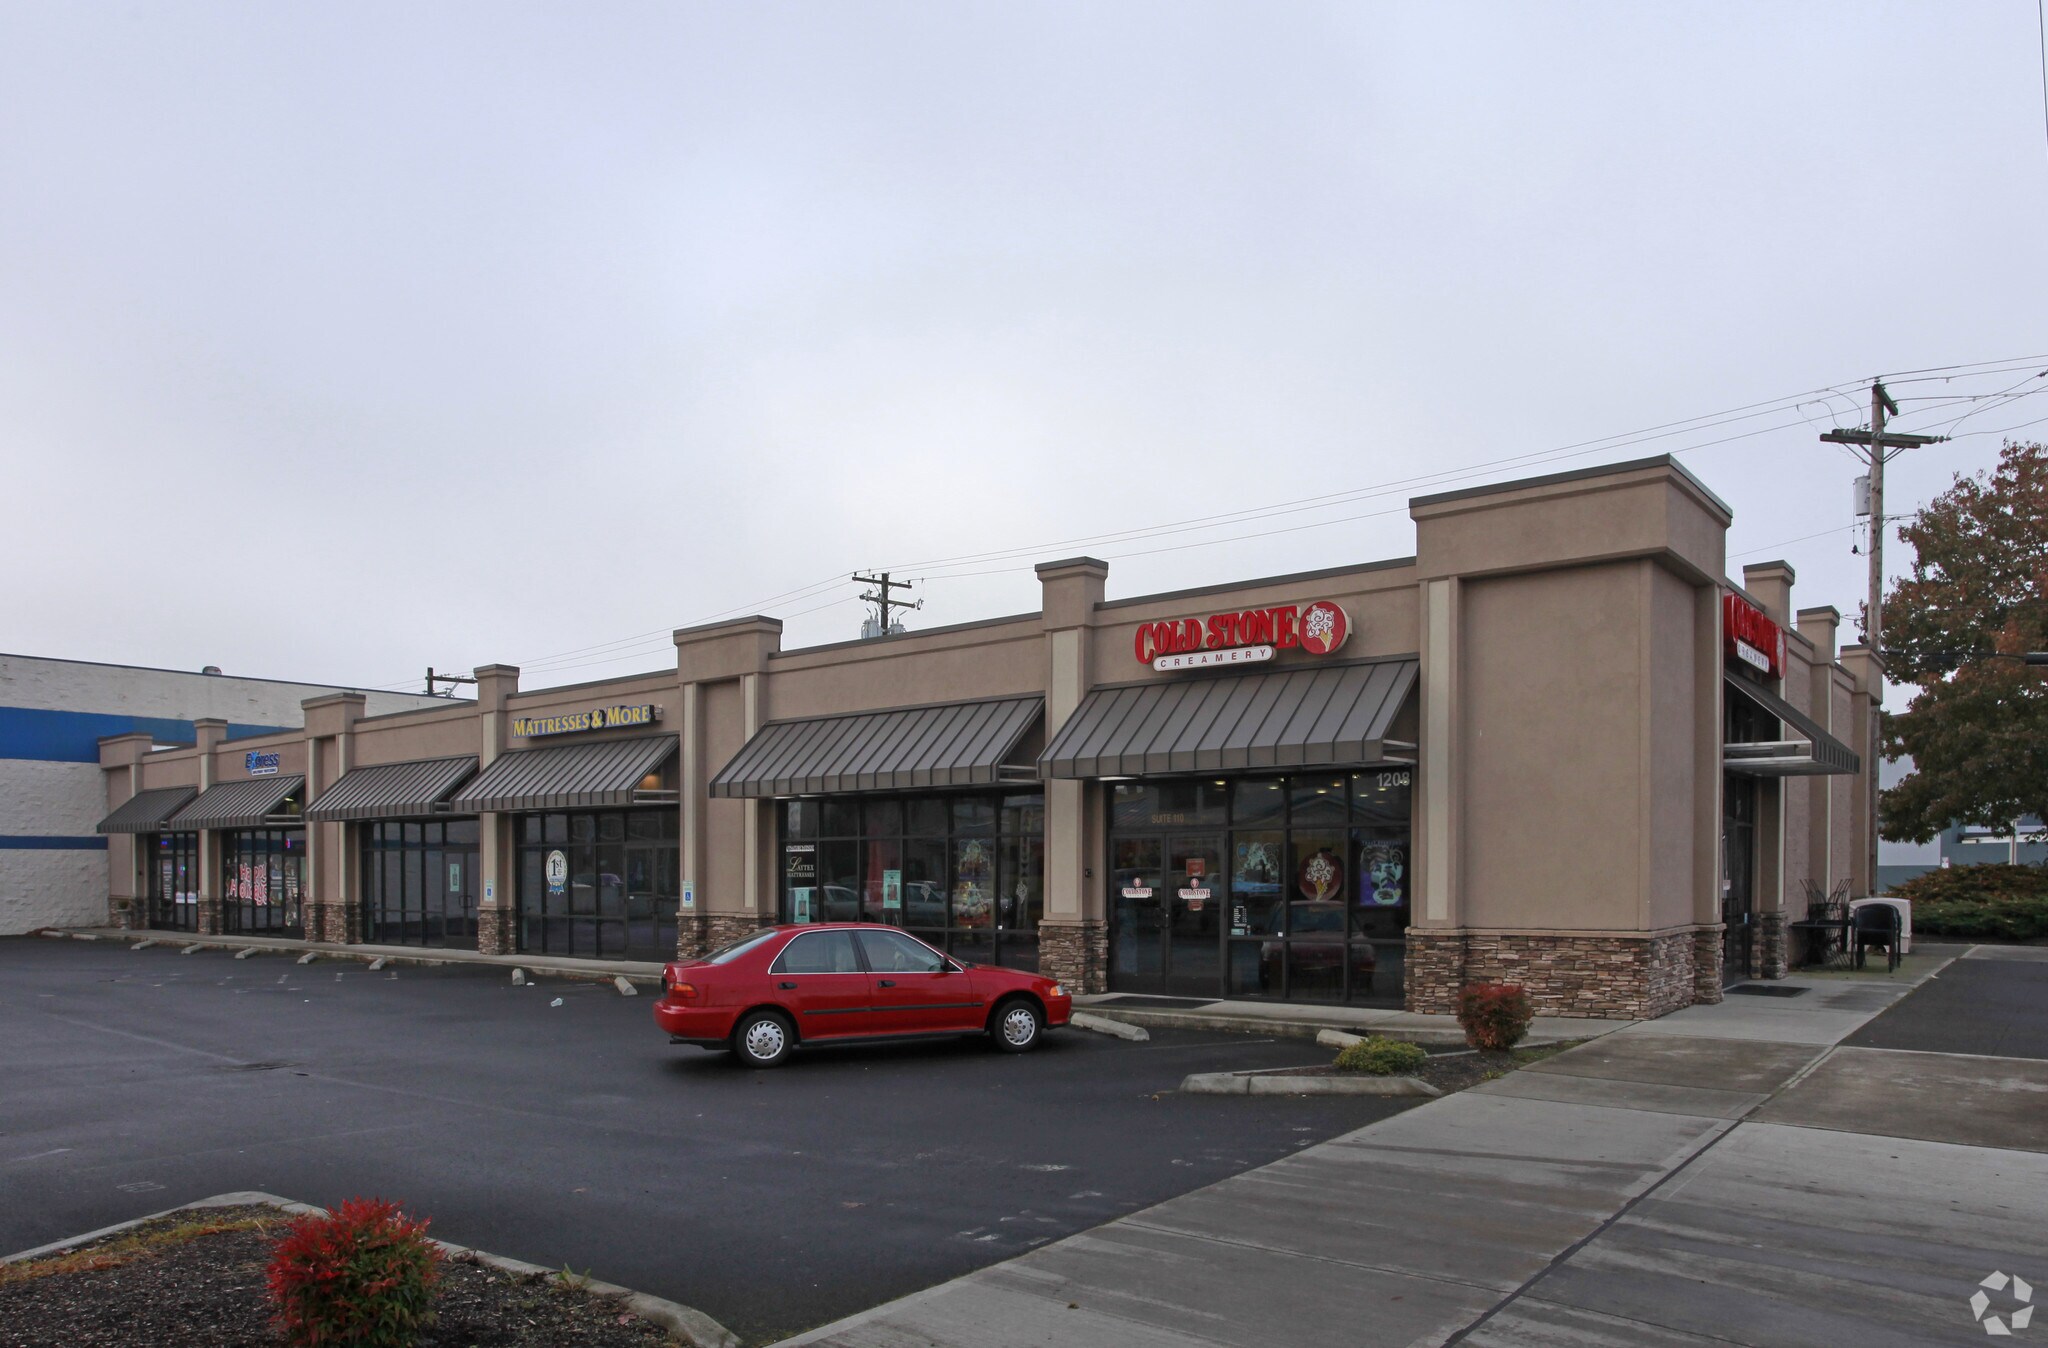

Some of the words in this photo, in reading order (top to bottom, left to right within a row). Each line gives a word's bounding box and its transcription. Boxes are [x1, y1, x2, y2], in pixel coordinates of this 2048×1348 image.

[1135, 618, 1203, 664] COLD
[1206, 606, 1298, 649] STONE
[1160, 649, 1267, 668] CREAMERY
[514, 714, 589, 736] MATTRESSES
[591, 709, 602, 728] &
[606, 705, 649, 725] MORE
[1376, 772, 1410, 787] 1208
[1151, 814, 1170, 824] SUITE
